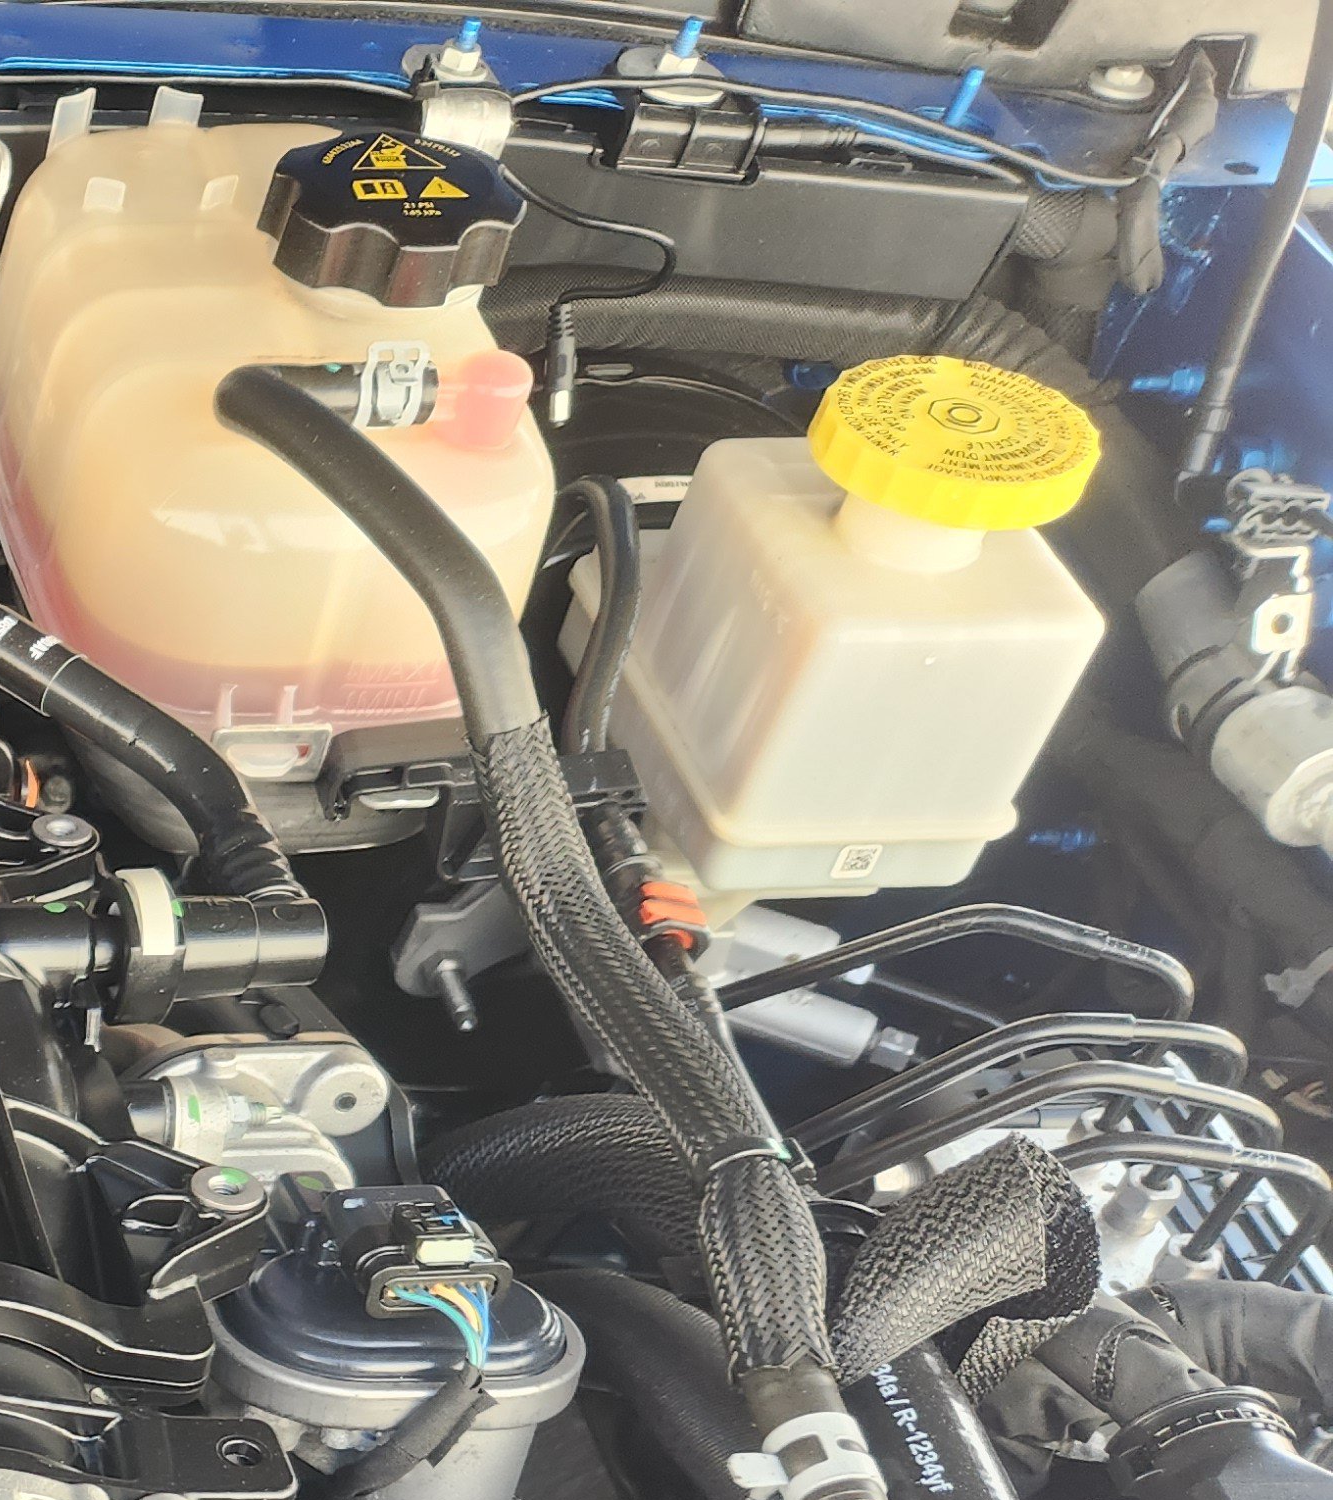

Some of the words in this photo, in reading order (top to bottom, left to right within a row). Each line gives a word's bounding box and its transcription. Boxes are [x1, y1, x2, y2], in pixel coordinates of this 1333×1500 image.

[884, 375, 924, 394] CLEAN
[970, 370, 1018, 390] AVANT
[836, 387, 856, 414] SEALED
[875, 388, 897, 415] FILLER
[1013, 387, 1034, 398] DE
[897, 386, 929, 420] WARNING
[1030, 398, 1050, 408] LE
[859, 411, 883, 427] USE
[873, 428, 912, 449] ONLY
[880, 416, 909, 433] CAP
[842, 415, 903, 457] CONTAINER
[943, 447, 979, 460] D'UN
[923, 462, 1026, 482] REMPLISSAGE
[938, 456, 1035, 472] UNIQUEMENT
[893, 1407, 954, 1493] R-1234yf
